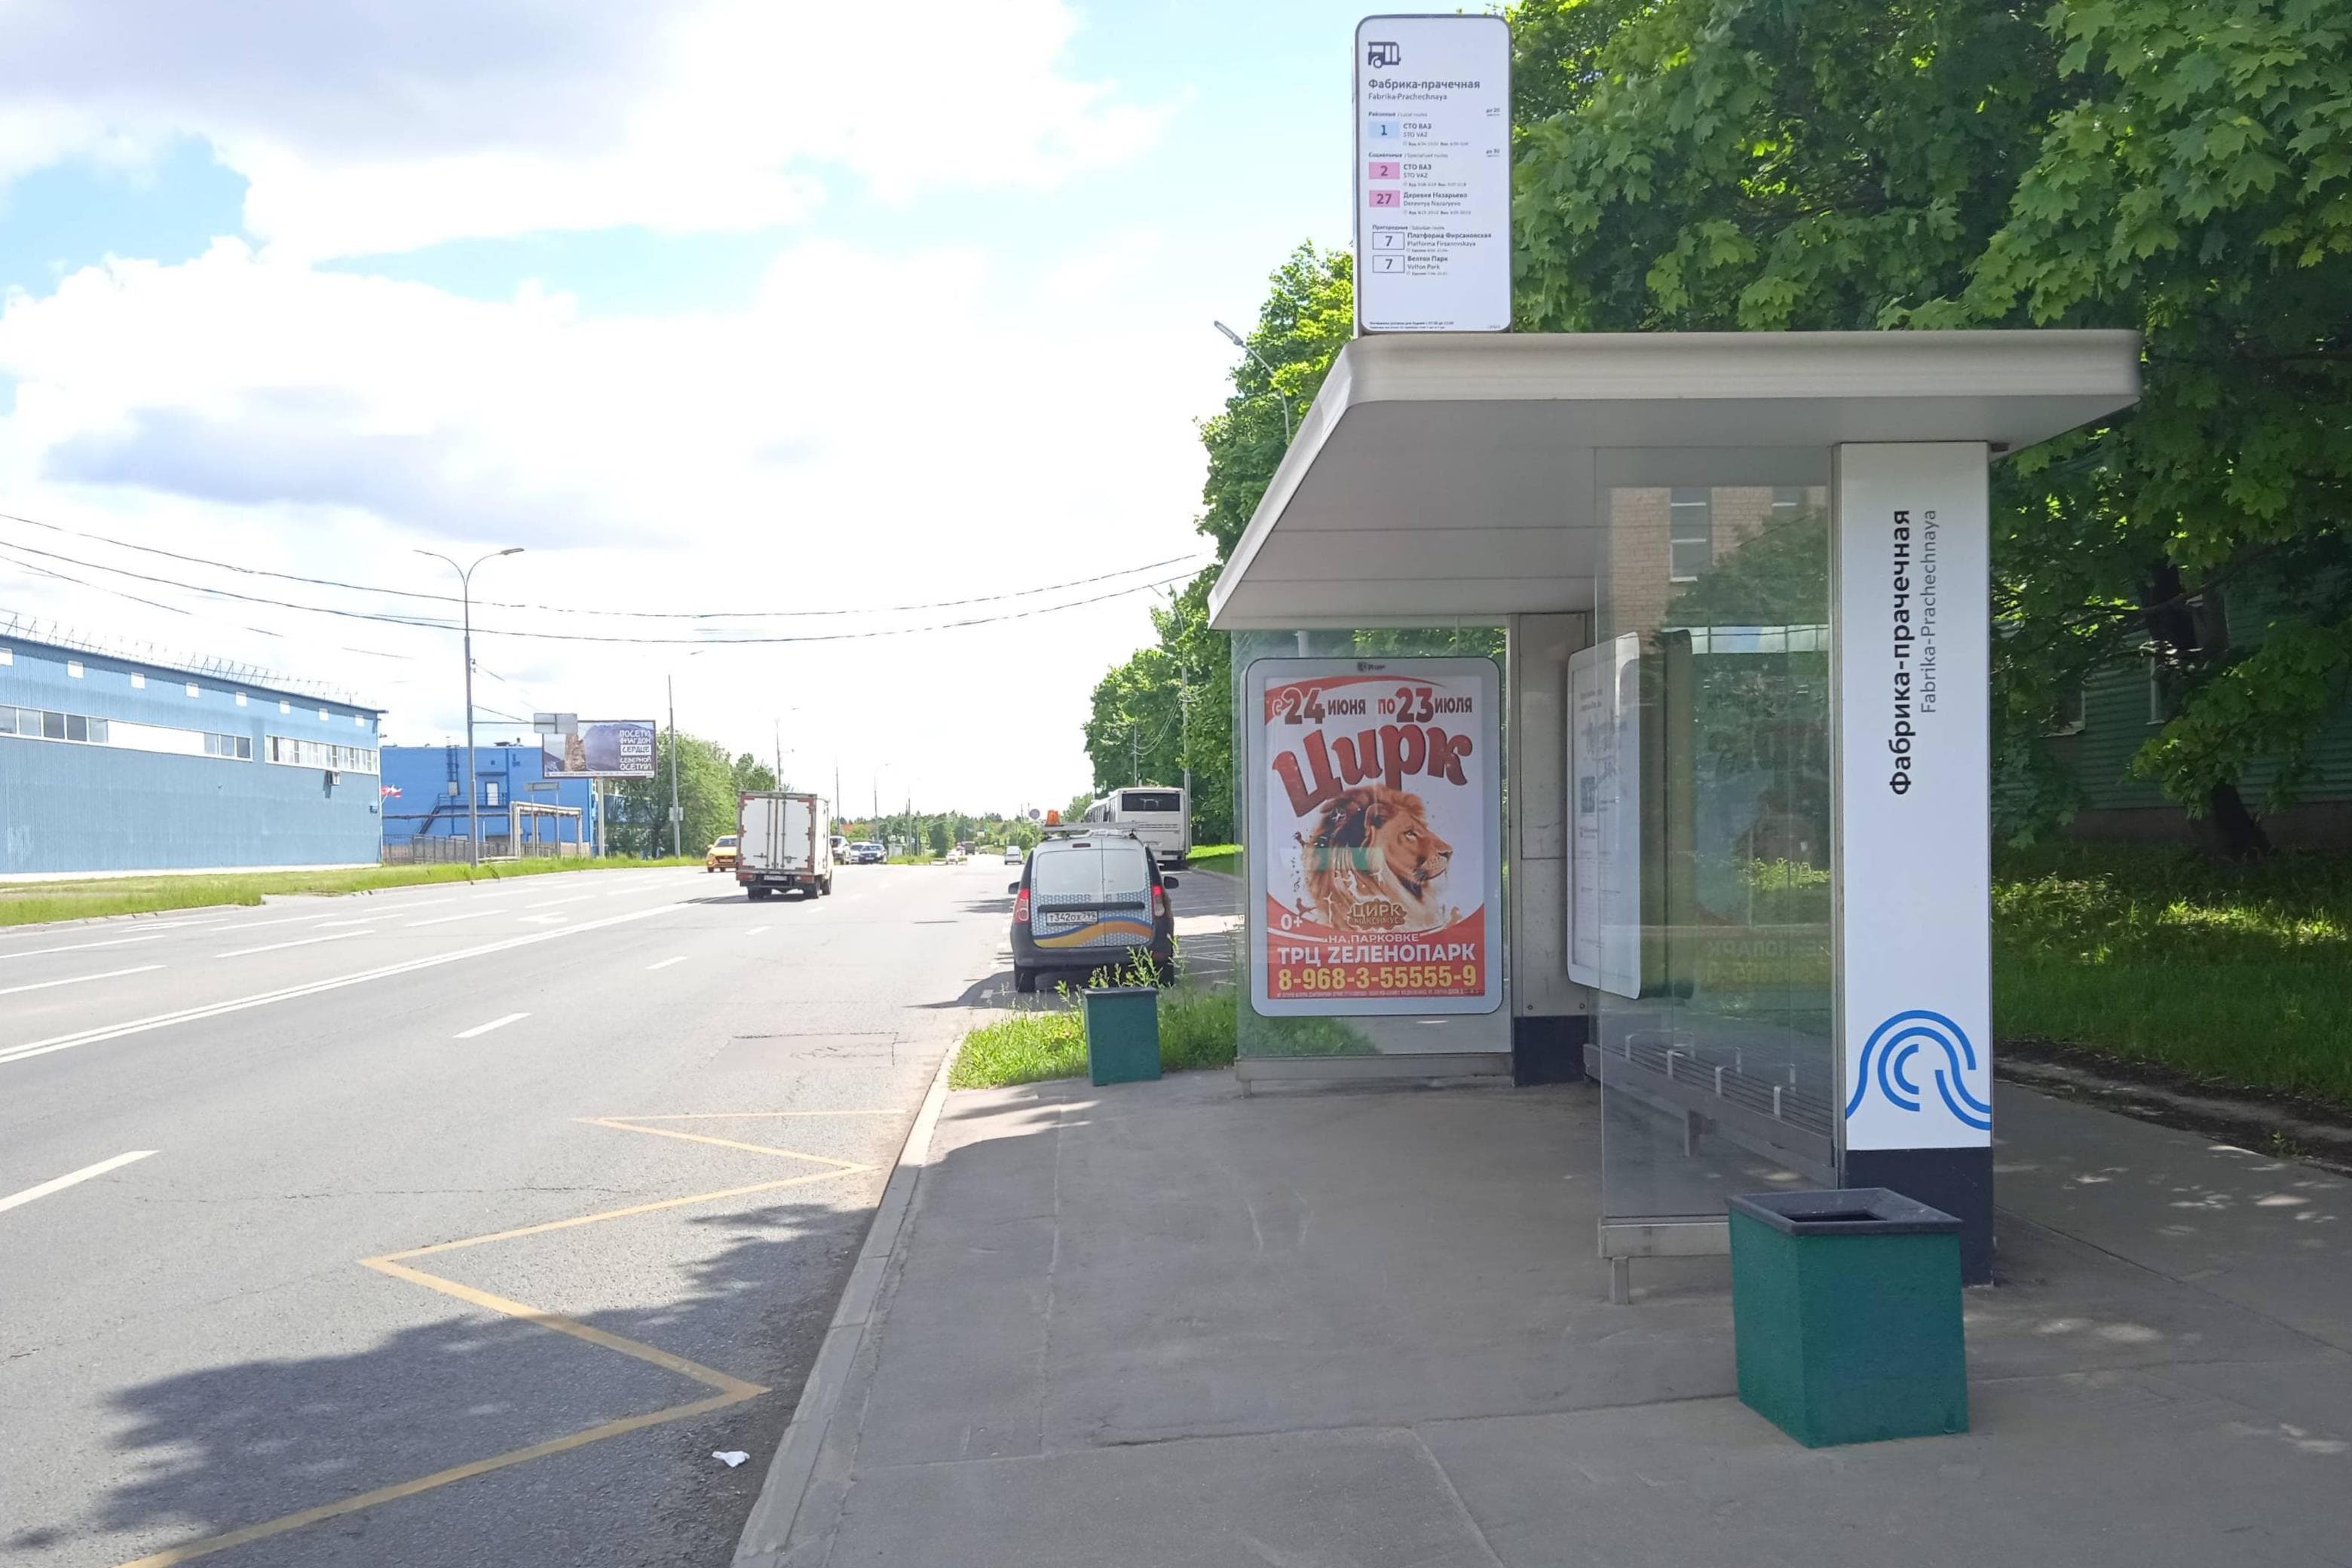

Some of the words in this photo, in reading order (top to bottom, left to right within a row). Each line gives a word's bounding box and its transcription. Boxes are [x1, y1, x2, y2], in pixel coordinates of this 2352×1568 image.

[1368, 79, 1481, 90] Фабрика-прачечная
[1368, 93, 1447, 101] Fabrika-Prachechnaya
[1381, 124, 1387, 136] 1
[1380, 165, 1389, 176] 2
[1377, 193, 1392, 204] 27
[1385, 235, 1393, 247] 7
[1385, 259, 1393, 270] 7
[1920, 510, 1940, 712] Fabrika-Prachechnaya
[1888, 510, 1916, 795] Фабрика-прачечная
[1282, 687, 1325, 724] 24
[1328, 699, 1366, 715] ИЮНЯ
[1378, 699, 1395, 715] ПО
[1395, 687, 1434, 723] 23
[1435, 697, 1473, 714] ИЮЛЯ
[1272, 724, 1473, 818] Цирк
[1352, 904, 1401, 920] ЦИРК
[1281, 914, 1303, 931] 0+
[1328, 935, 1347, 943] НА
[1351, 933, 1419, 943] ПАРКОВКЕ
[1278, 947, 1321, 966] ТРЦ
[1279, 965, 1476, 991] 8-968-3-55555-9
